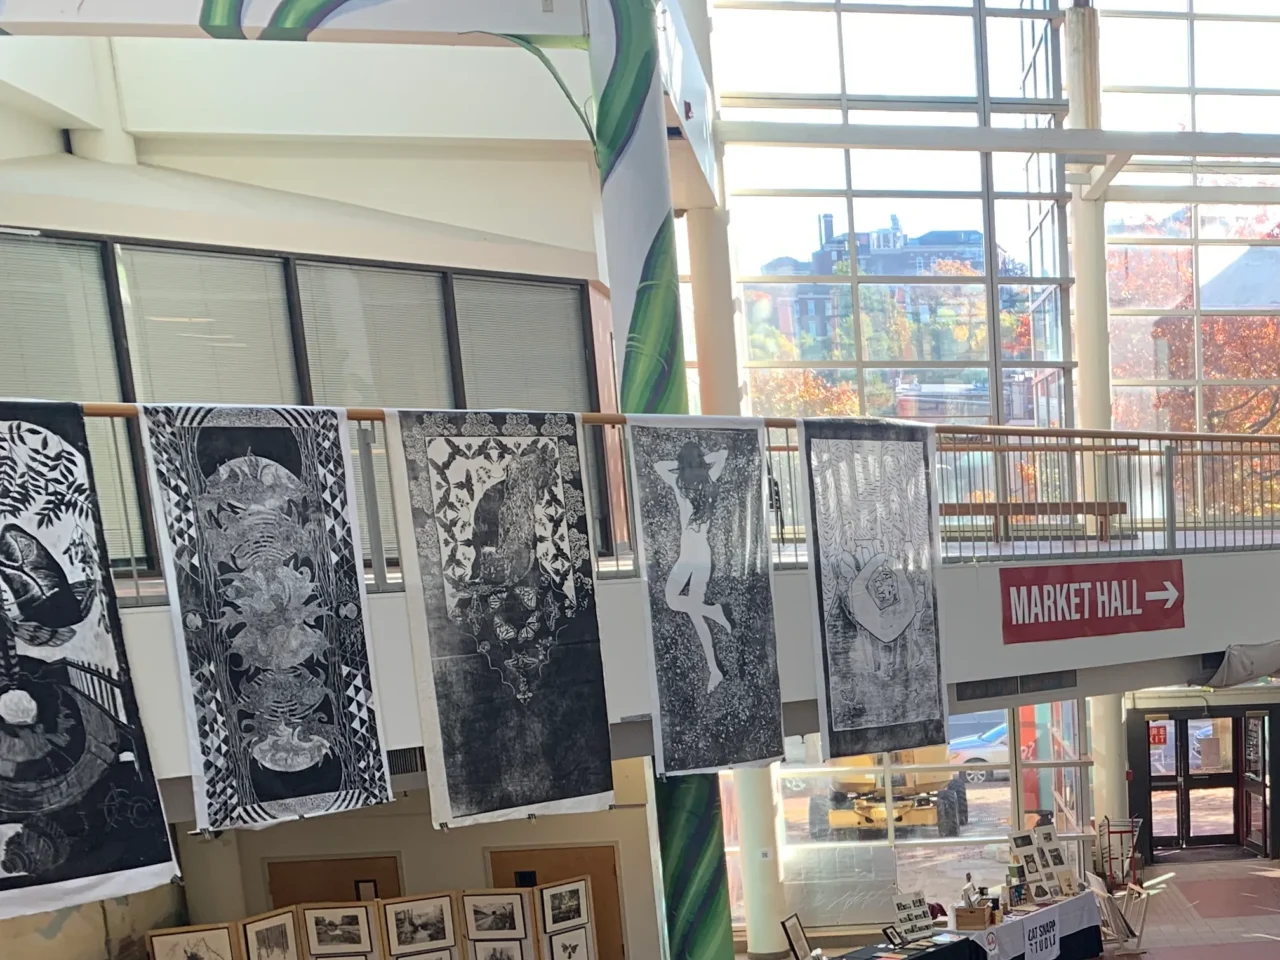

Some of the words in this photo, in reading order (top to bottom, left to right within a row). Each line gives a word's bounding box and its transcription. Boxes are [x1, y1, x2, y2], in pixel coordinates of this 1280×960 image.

[1009, 582, 1092, 625] MARKET
[1096, 579, 1143, 618] HALL
[1150, 727, 1166, 736] RE
[1028, 926, 1038, 941] CAT
